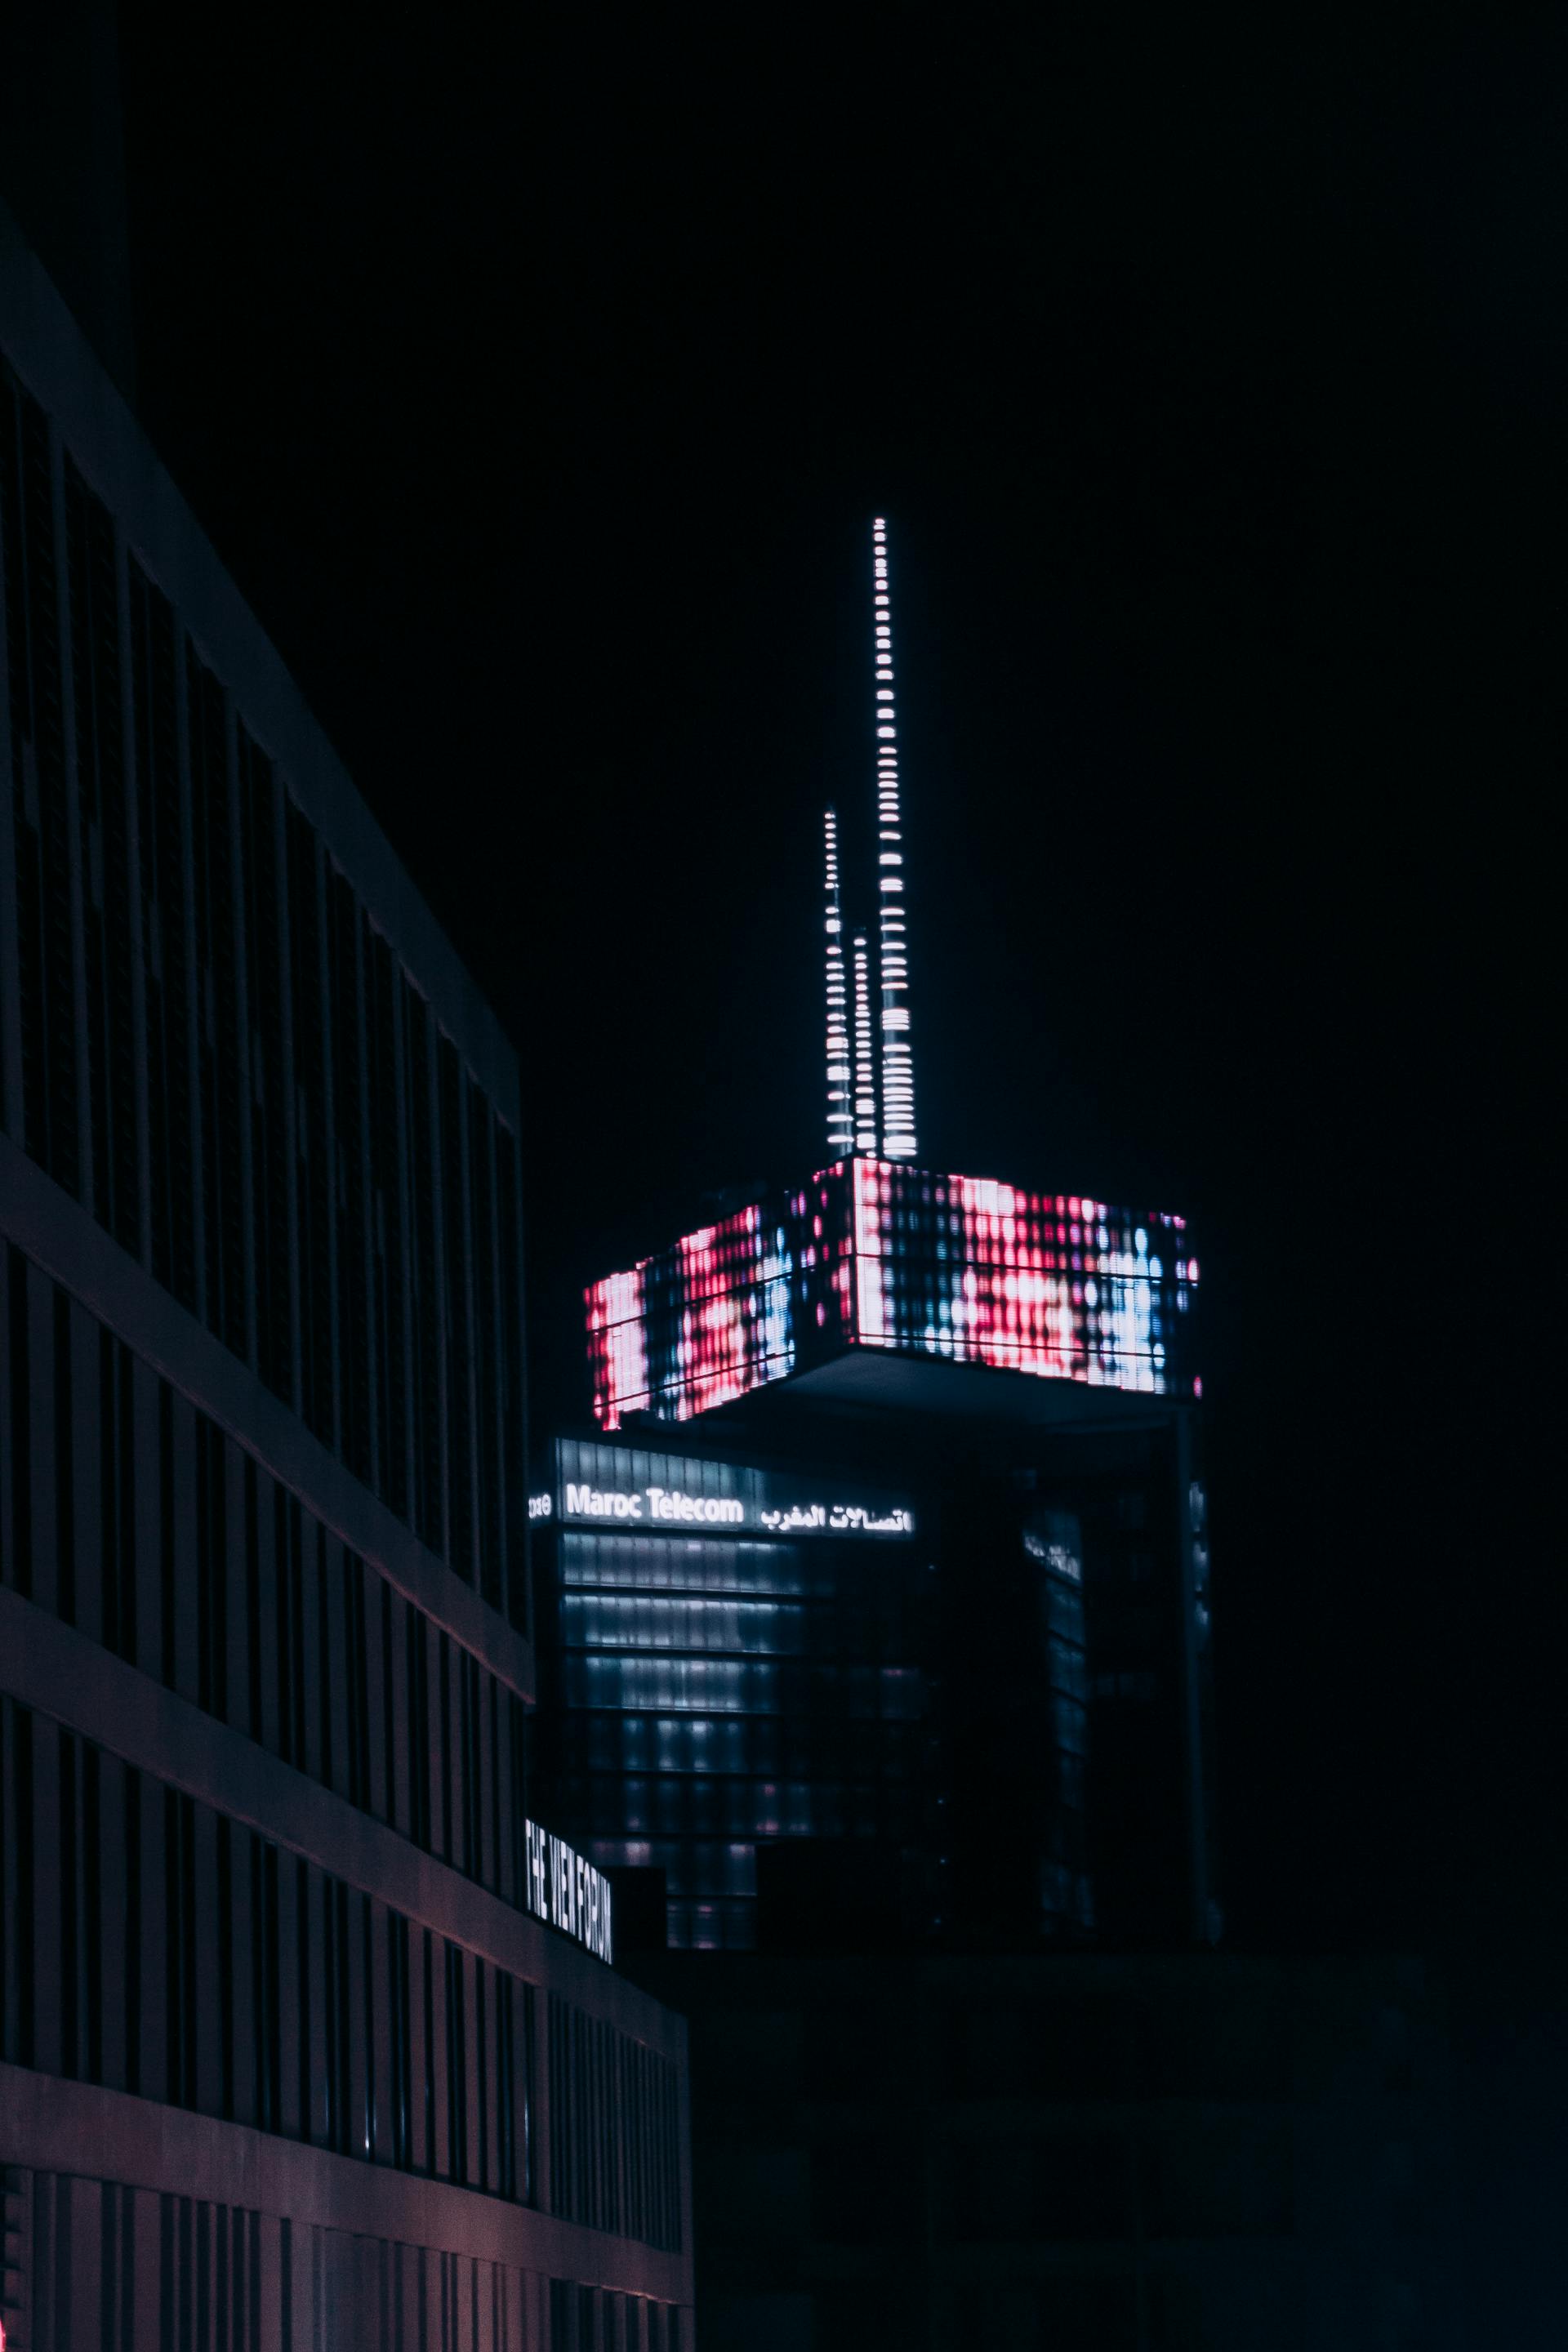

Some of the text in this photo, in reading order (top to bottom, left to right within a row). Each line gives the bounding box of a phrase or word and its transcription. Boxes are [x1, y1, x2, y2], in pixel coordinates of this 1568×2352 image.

[566, 1483, 642, 1518] Maroc
[645, 1487, 744, 1522] Telecom
[760, 1505, 913, 1531] اتصالات المغرب
[525, 1819, 547, 1920] THE
[577, 1855, 612, 1965] FORUM
